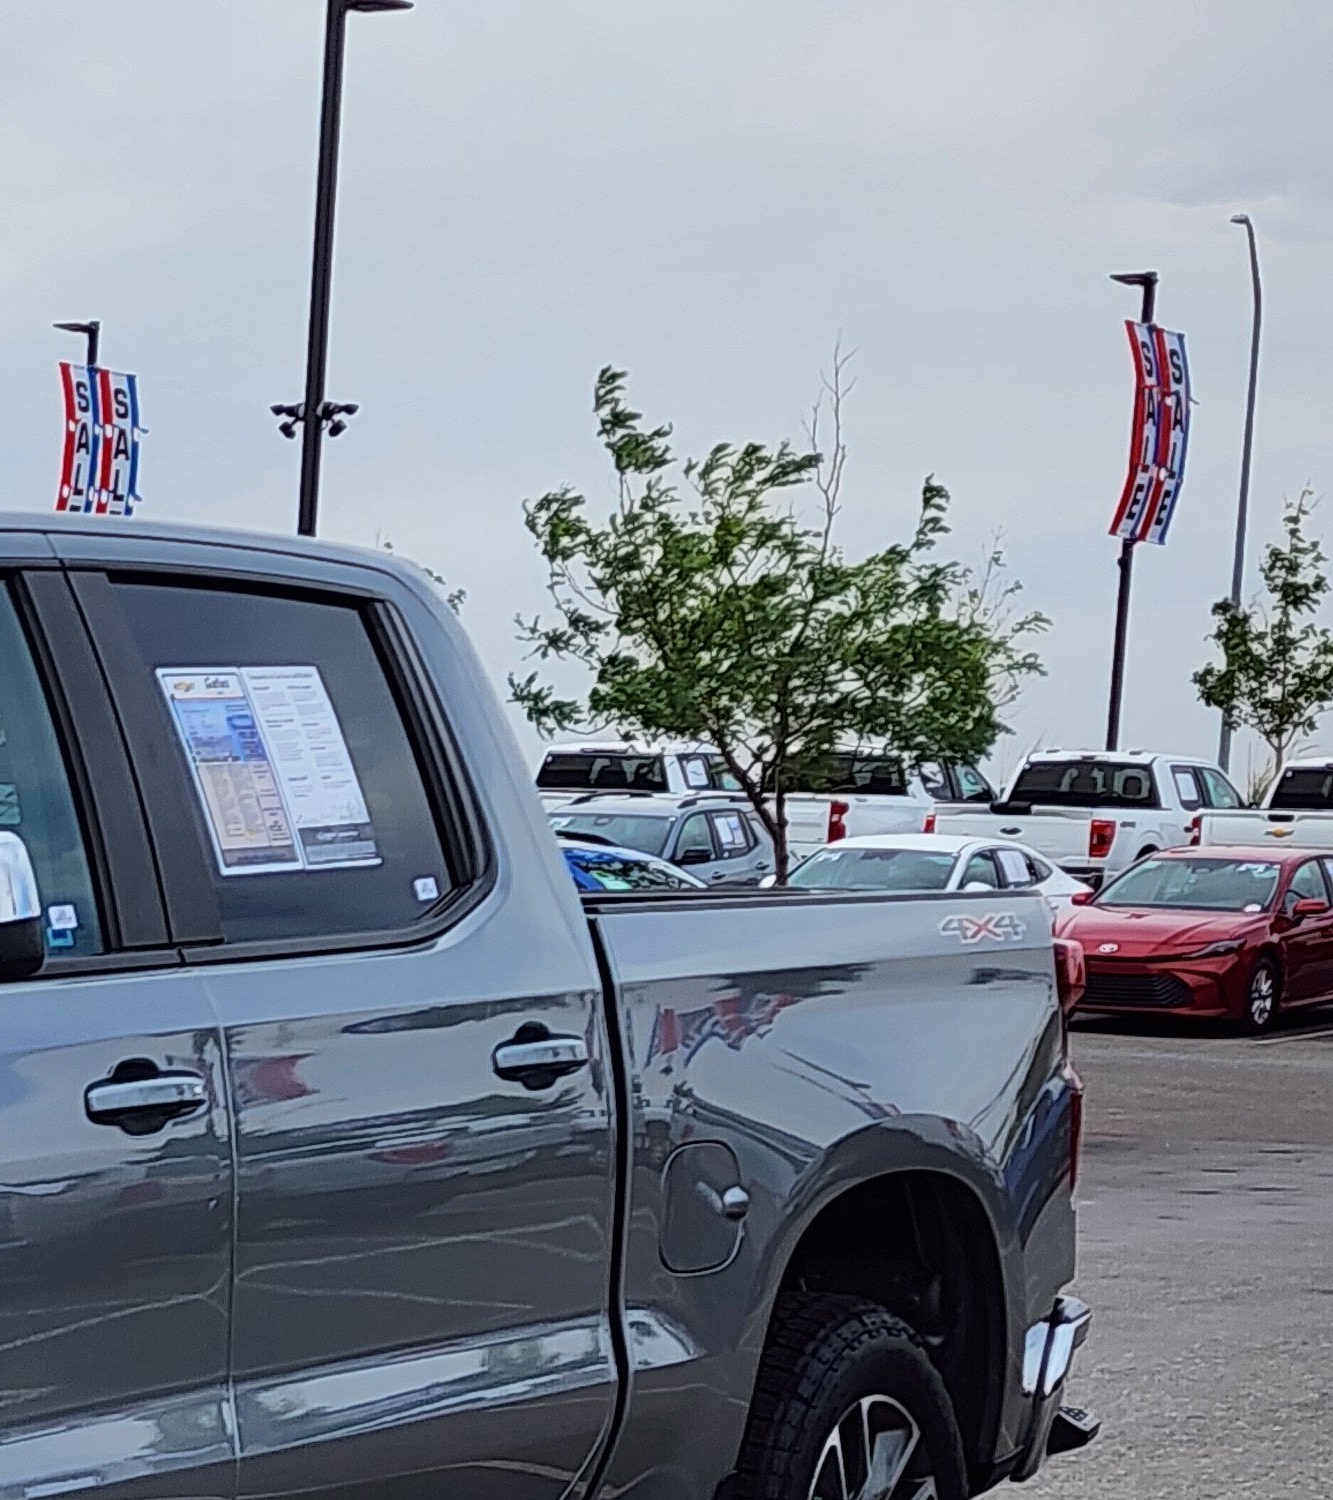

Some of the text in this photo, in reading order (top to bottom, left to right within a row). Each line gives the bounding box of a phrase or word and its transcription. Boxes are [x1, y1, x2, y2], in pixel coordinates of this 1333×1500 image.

[69, 381, 90, 512] SAL
[109, 388, 130, 515] SAL
[1126, 340, 1157, 520] SALE
[1154, 348, 1184, 526] SALE
